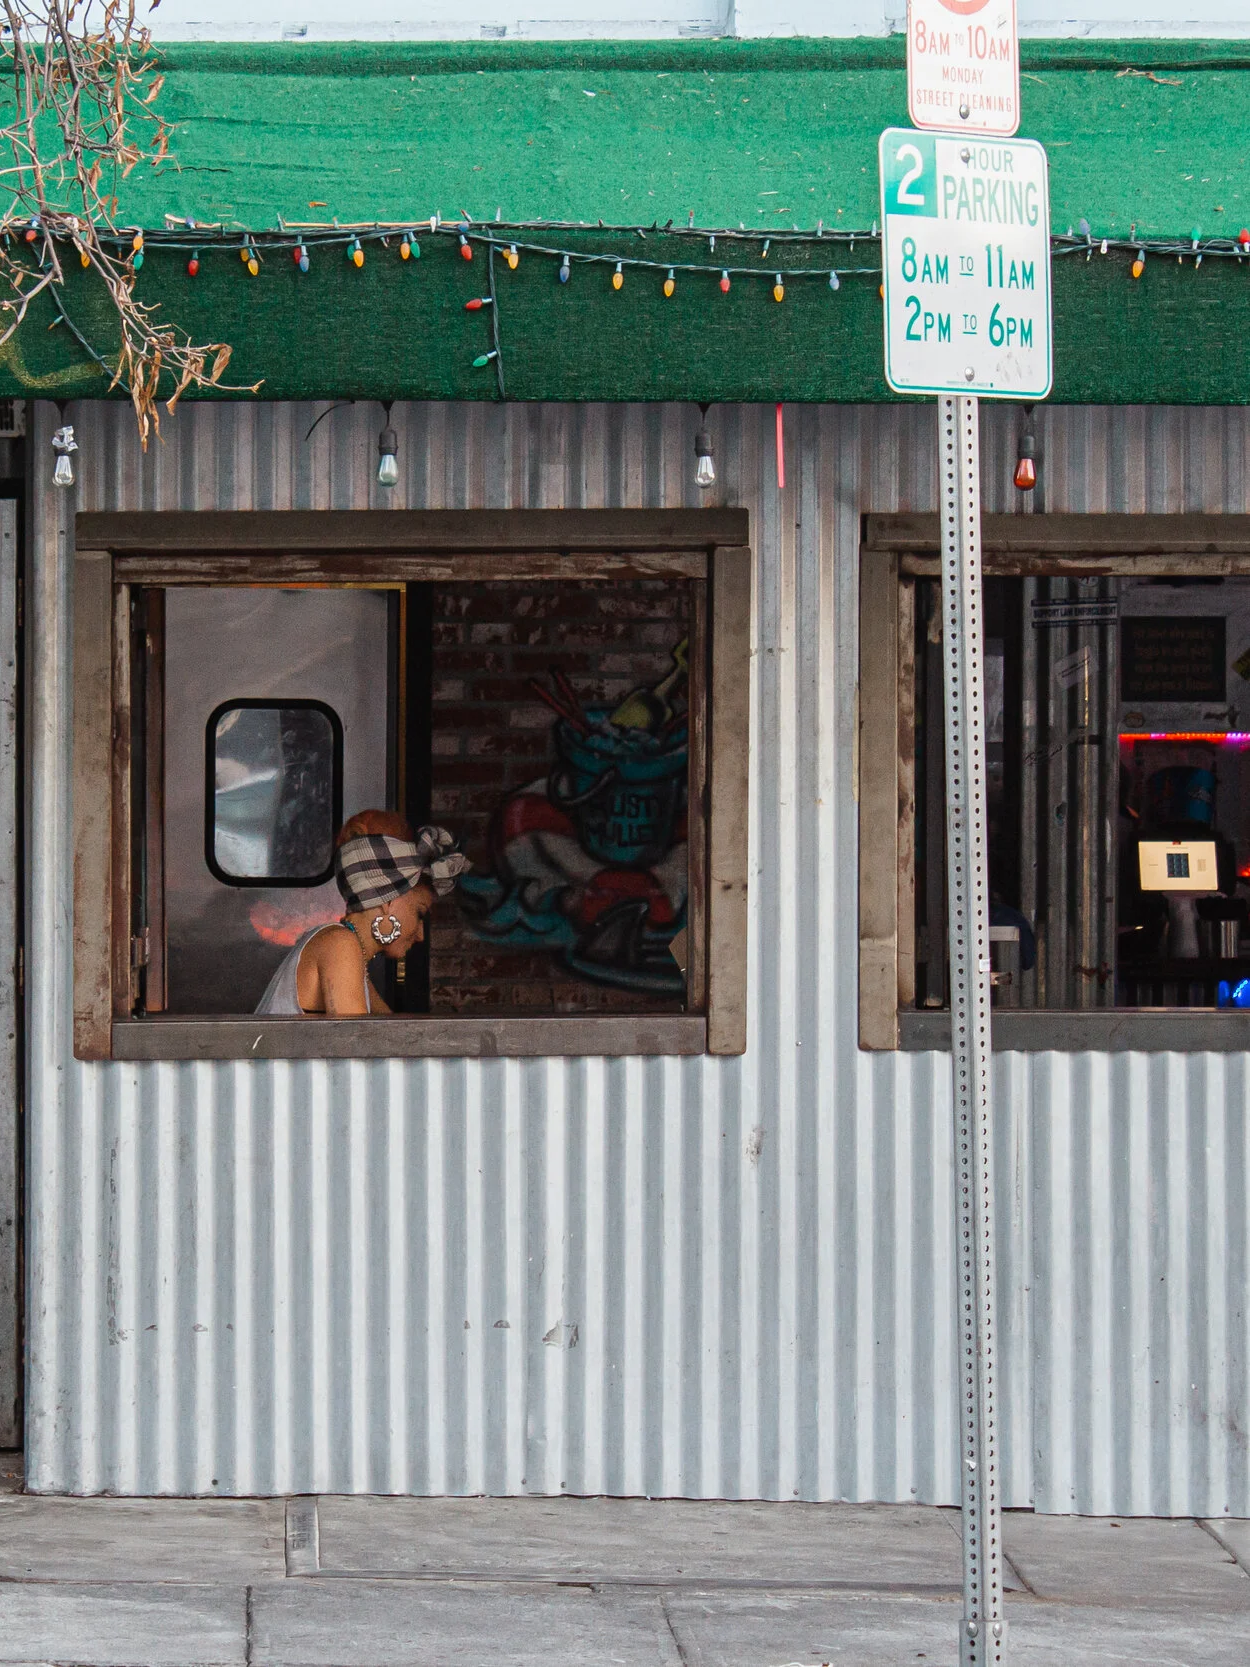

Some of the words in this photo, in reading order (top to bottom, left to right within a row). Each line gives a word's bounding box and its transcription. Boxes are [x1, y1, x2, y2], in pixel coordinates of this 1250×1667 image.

[915, 19, 950, 56] 8AM
[955, 33, 964, 46] TO
[967, 24, 1010, 62] 10AM
[916, 88, 954, 107] STREET
[959, 92, 1012, 113] CLEANING
[942, 65, 984, 85] MONDAY
[896, 143, 925, 206] 2
[966, 147, 1014, 173] HOUR
[942, 174, 1039, 227] PARKING
[901, 236, 949, 285] 8AM
[959, 255, 974, 272] TO
[985, 243, 1035, 291] 11AM
[905, 295, 951, 343] 2PM
[962, 314, 978, 331] TO
[989, 302, 1033, 348] 6PM
